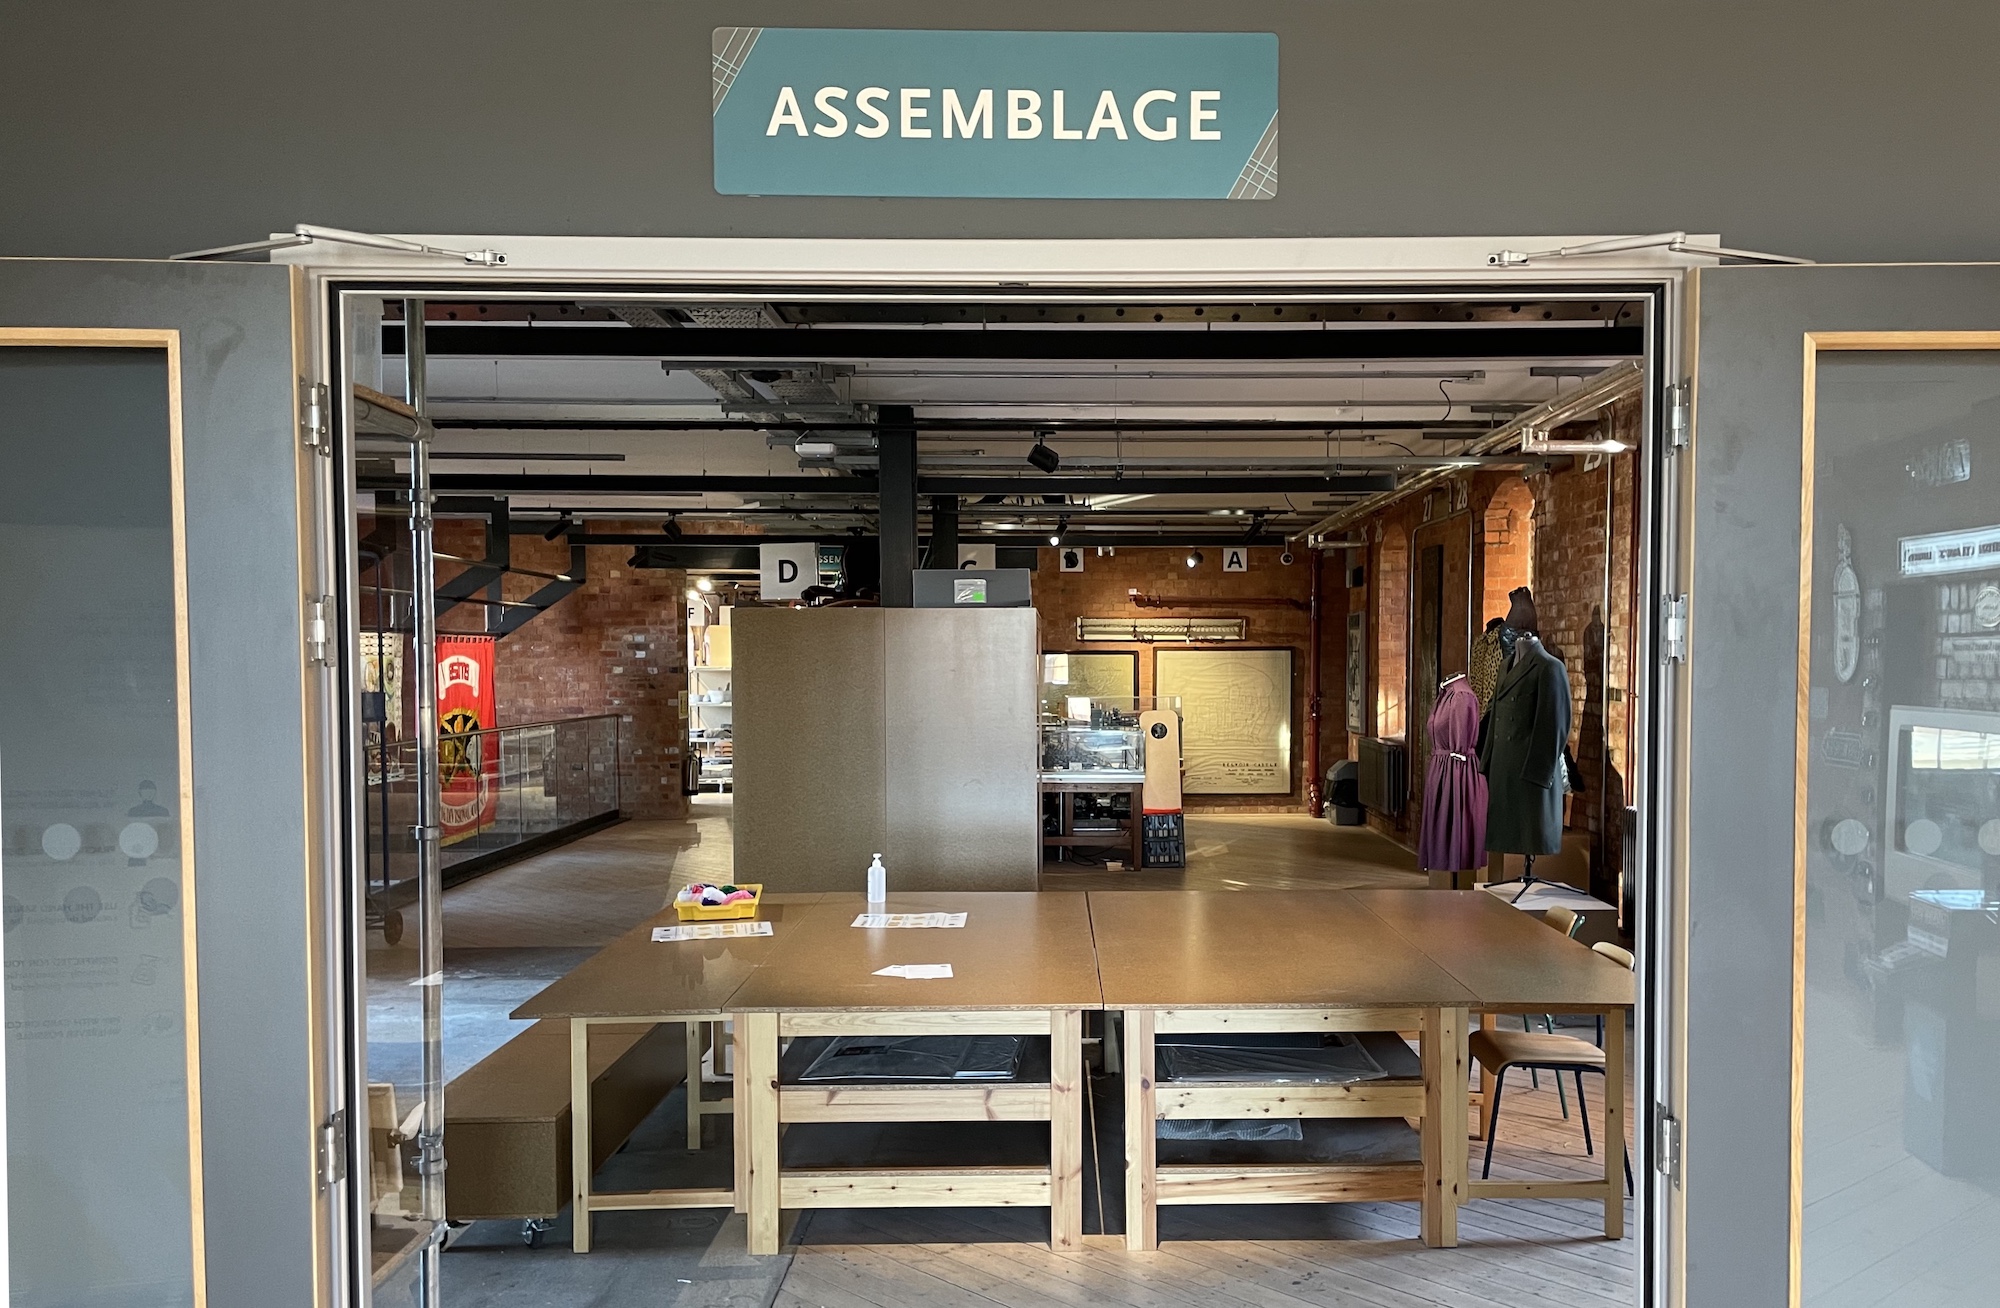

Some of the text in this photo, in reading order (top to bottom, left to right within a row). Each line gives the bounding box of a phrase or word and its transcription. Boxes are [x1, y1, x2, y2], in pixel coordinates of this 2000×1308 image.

[766, 86, 1222, 142] ASSEMBLAGE
[1422, 494, 1433, 522] 27
[1456, 480, 1468, 510] 28
[778, 559, 798, 583] D
[1227, 551, 1243, 568] A
[688, 607, 695, 619] F
